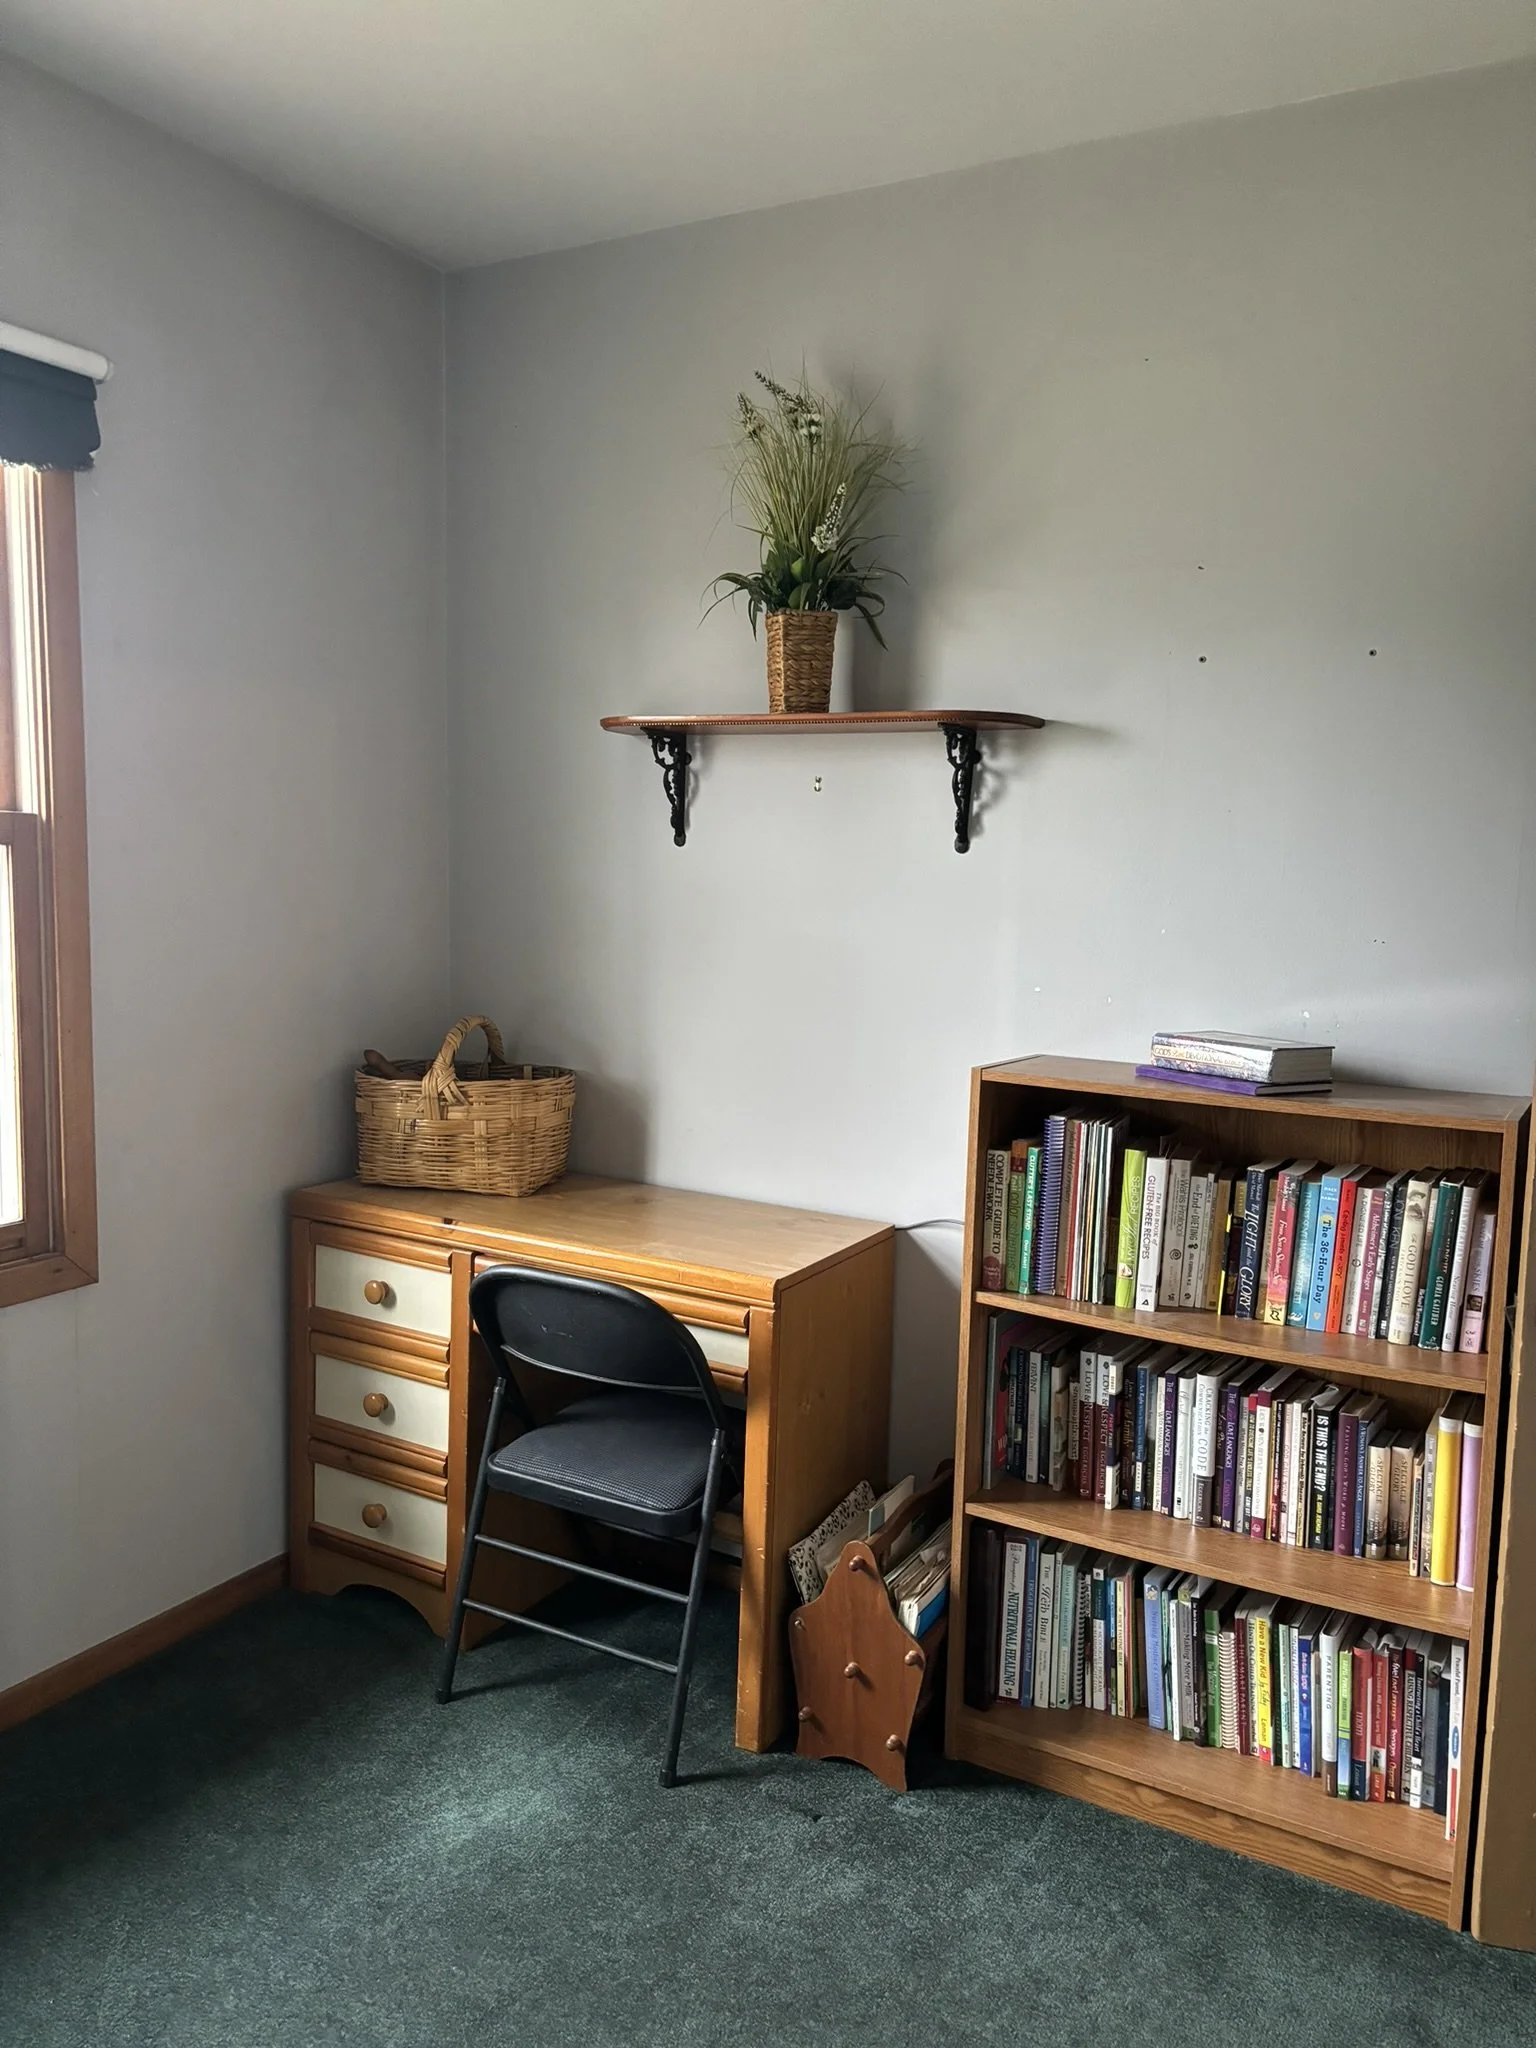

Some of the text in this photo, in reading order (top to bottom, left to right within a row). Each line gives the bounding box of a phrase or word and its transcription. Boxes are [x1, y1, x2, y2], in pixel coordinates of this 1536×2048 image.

[985, 1153, 995, 1221] NEEDLEWORK
[1027, 1155, 1035, 1190] CLUTTER'S
[992, 1154, 1004, 1254] COMPLETE GUIDE TO
[1009, 1193, 1021, 1217] color
[1130, 1176, 1140, 1214] RECIPES
[1251, 1204, 1260, 1212] The
[1142, 1176, 1155, 1259] GLUTEN-FREE RECIPES
[1176, 1205, 1186, 1237] Protocol
[1189, 1192, 1202, 1241] End DIETING
[1244, 1210, 1259, 1251] LIGHT
[1279, 1219, 1287, 1234] From
[1152, 1238, 1158, 1246] of
[1364, 1214, 1380, 1290] Alzheimer's Early Stages
[1457, 1225, 1468, 1263] GRAHAM
[1314, 1219, 1331, 1304] The 36-Hour Day
[1405, 1245, 1417, 1270] GOD
[1239, 1267, 1253, 1311] GLORY
[1401, 1280, 1413, 1308] LOVE
[1434, 1276, 1444, 1297] GLORIA
[1448, 1300, 1456, 1319] Home
[1085, 1370, 1094, 1393] LOVE
[1102, 1398, 1108, 1406] &
[1205, 1388, 1213, 1426] CRACKING
[1083, 1402, 1093, 1441] RESPECT
[1100, 1405, 1109, 1446] RESPECT
[1123, 1420, 1133, 1447] Family
[1197, 1384, 1207, 1471] COMMUNICATION CODE
[1318, 1416, 1328, 1424] IS
[1316, 1427, 1328, 1447] THIS
[1225, 1437, 1234, 1468] LANGUAGES
[1315, 1449, 1326, 1466] THE
[1314, 1467, 1326, 1491] END?
[1392, 1467, 1400, 1495] GLORY
[1399, 1461, 1408, 1504] SPECTACLE
[1040, 1584, 1053, 1614] Herb
[1003, 1591, 1019, 1686] NUTRITIONAL HEALING
[1039, 1617, 1049, 1644] BIBLE
[1183, 1634, 1191, 1660] Making
[1249, 1646, 1255, 1657] ON
[1184, 1681, 1192, 1696] Milk
[1415, 1677, 1423, 1710] Instructing
[1355, 1711, 1363, 1736] mom
[1404, 1673, 1414, 1774] RAISING RESPECTFUL CHILDREN
